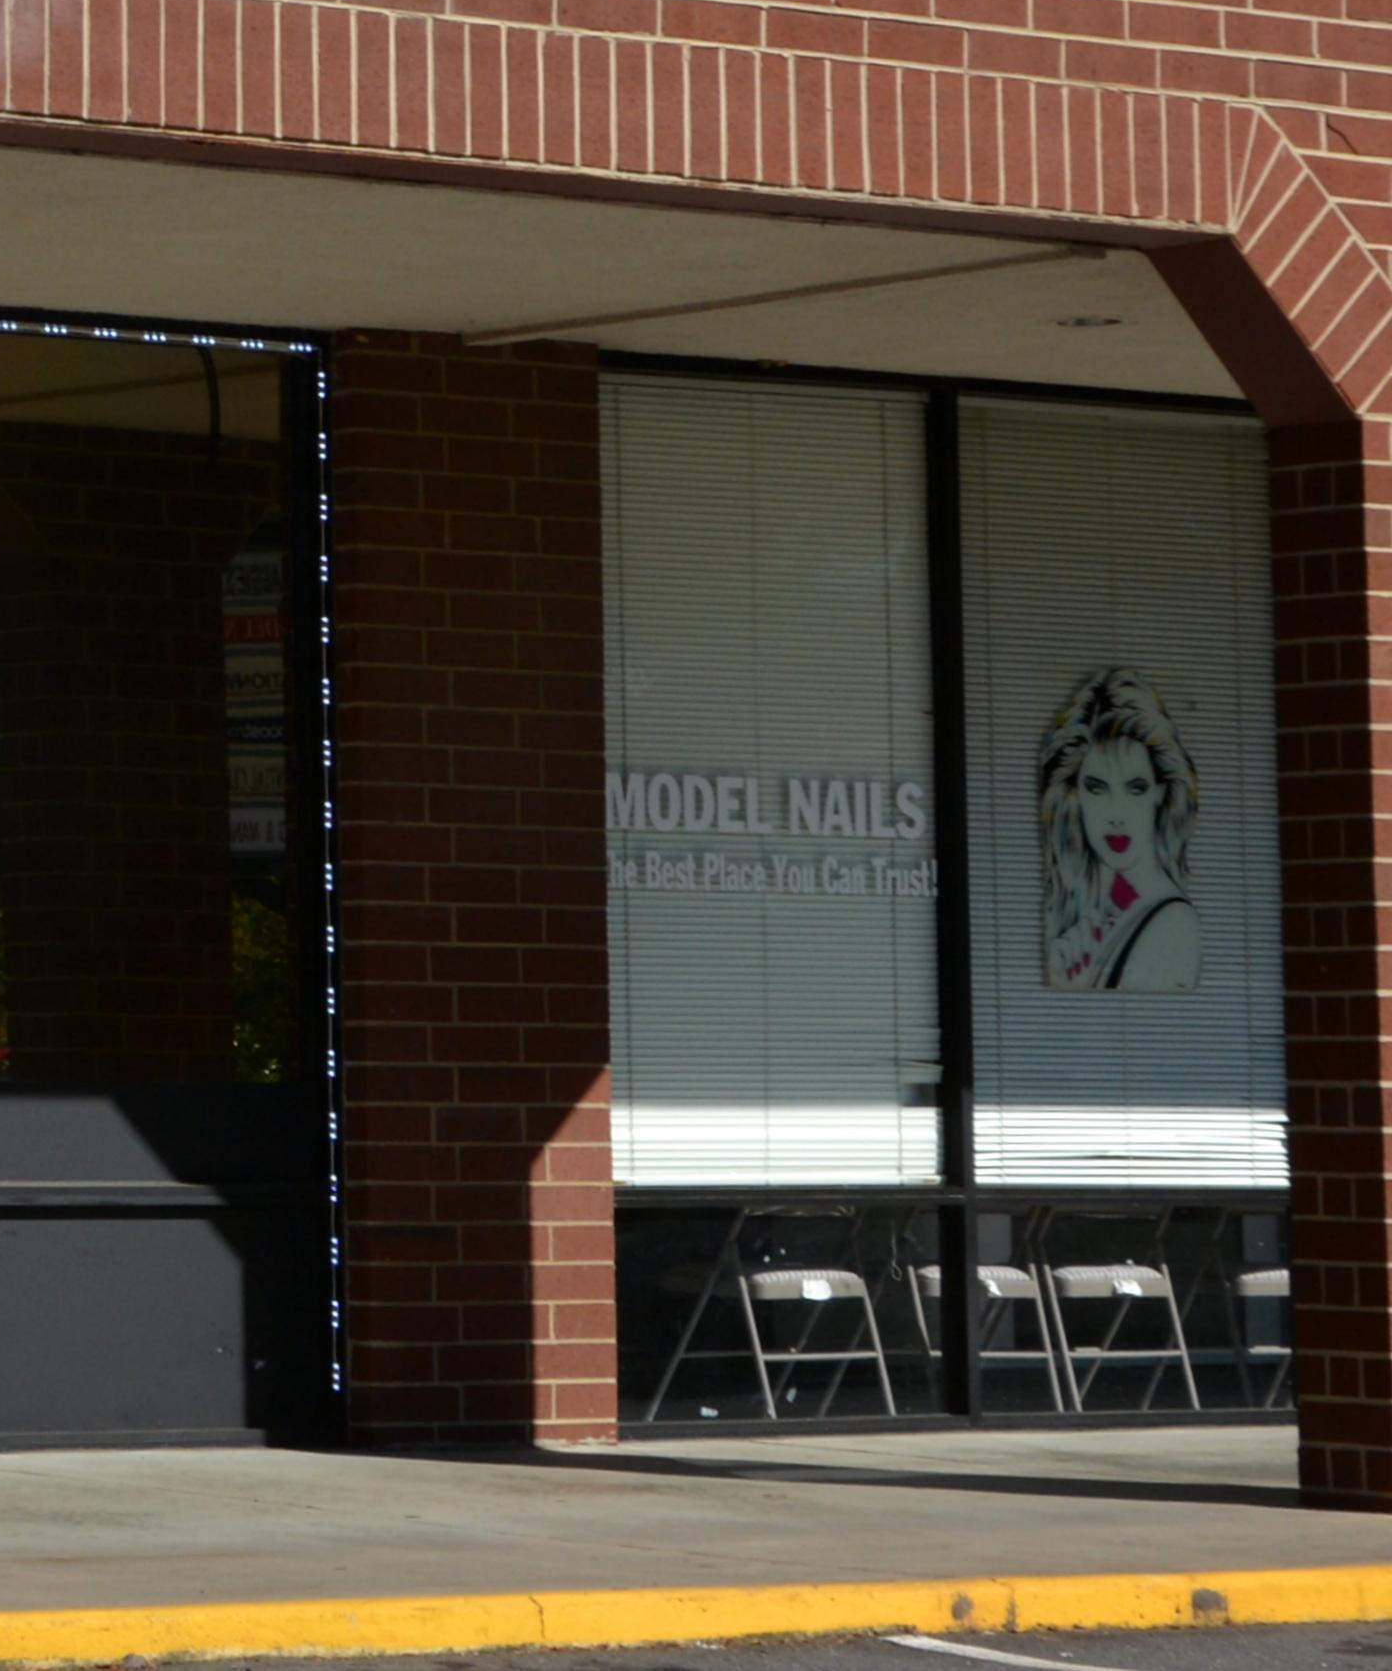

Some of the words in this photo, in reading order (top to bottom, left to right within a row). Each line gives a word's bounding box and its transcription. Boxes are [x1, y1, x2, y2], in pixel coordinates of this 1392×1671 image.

[605, 771, 773, 834] MODEL
[789, 778, 927, 840] NAILS
[607, 849, 638, 890] he
[645, 850, 698, 890] Best
[704, 852, 767, 892] Place
[771, 855, 816, 894] You
[822, 855, 867, 895] Can
[871, 857, 939, 898] Trust!
